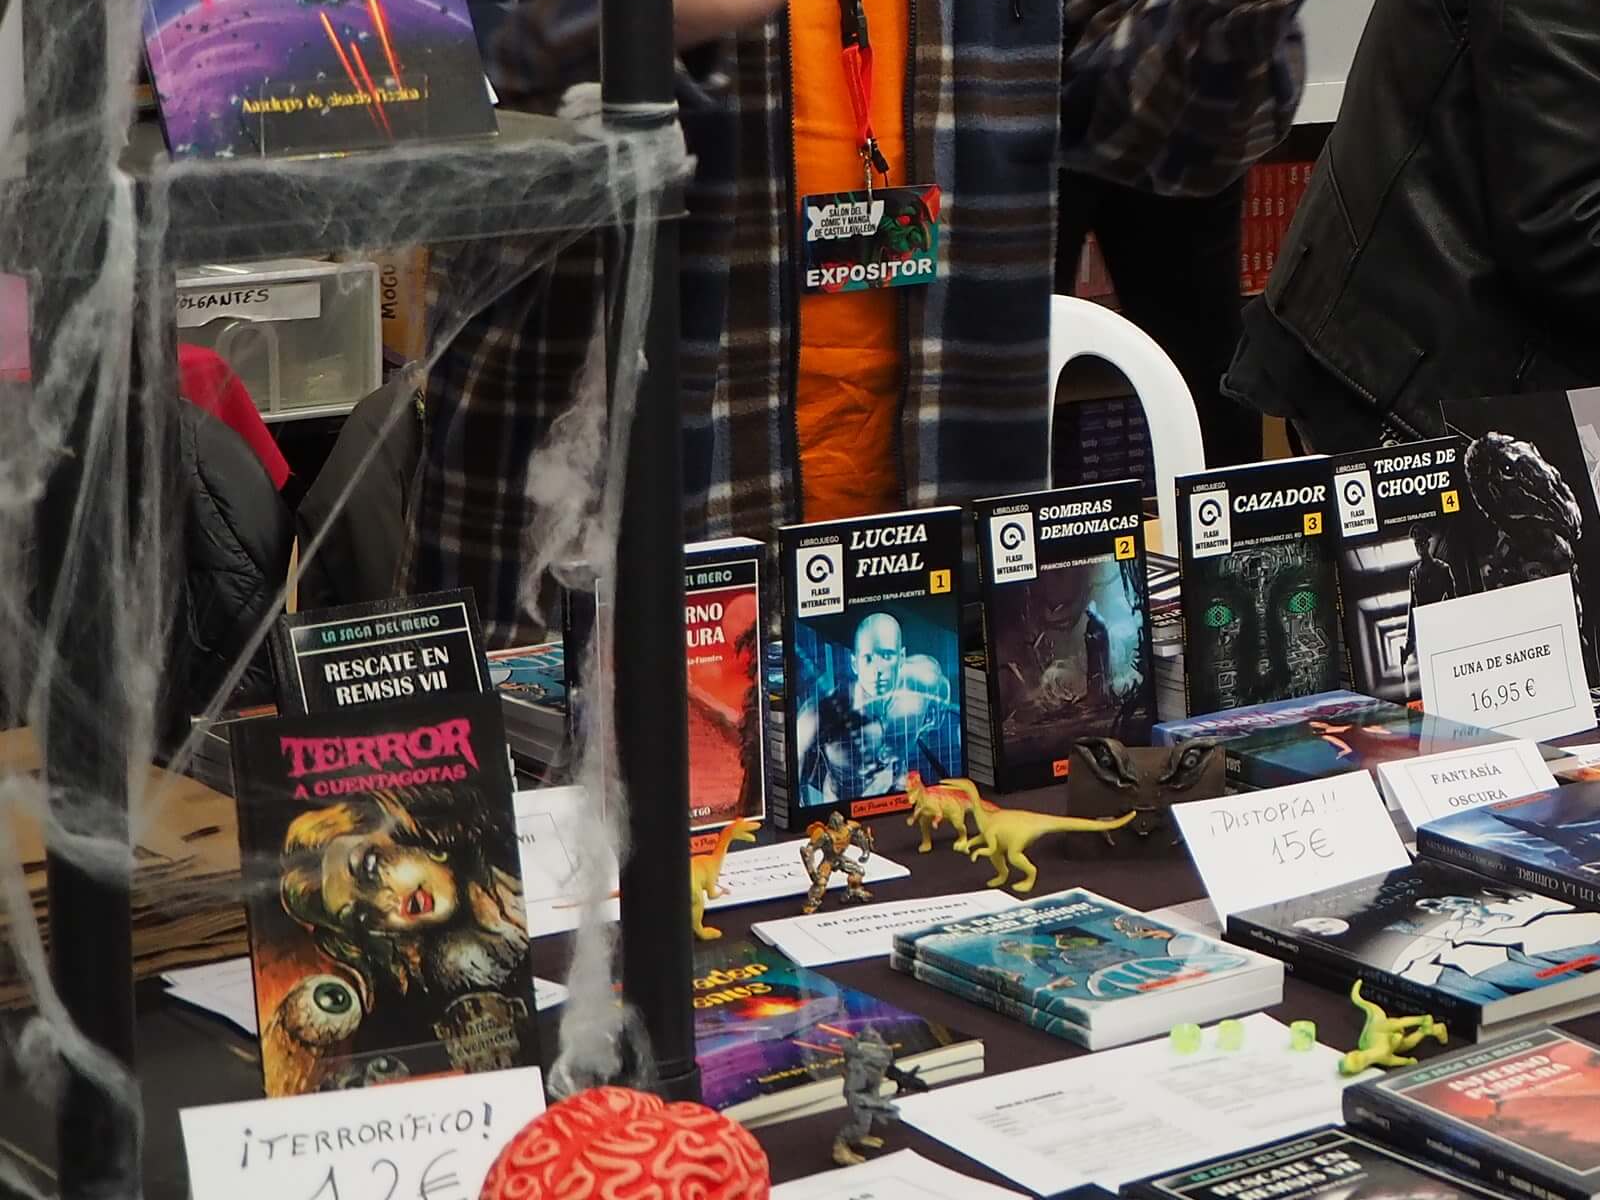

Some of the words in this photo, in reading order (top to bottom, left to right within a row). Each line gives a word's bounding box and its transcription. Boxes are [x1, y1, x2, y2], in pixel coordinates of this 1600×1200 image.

[821, 217, 841, 227] CÓMIC
[848, 215, 871, 225] MANGA
[829, 207, 849, 217] SALÓN
[850, 206, 863, 215] DEL
[823, 225, 854, 237] CASTILLA
[860, 223, 876, 233] LEÓN
[806, 258, 932, 287] EXPOSITOR
[177, 287, 270, 310] OLGANTES
[1374, 452, 1432, 474] TROPAS
[1436, 448, 1456, 464] DE
[1377, 471, 1450, 498] CHOQUE
[1039, 499, 1112, 521] SOMBRAS
[1233, 485, 1326, 513] CAZADOR
[1350, 509, 1365, 518] FLASH
[849, 524, 928, 550] LUCHA
[1040, 514, 1139, 540] DEMONIACAS
[1203, 530, 1219, 539] FLASH
[799, 535, 840, 547] LIBROJUEGO
[855, 552, 925, 578] FINAL
[1005, 554, 1023, 563] FLASH
[800, 597, 841, 609] INTERACTIVO
[811, 588, 830, 597] FLASH
[321, 629, 337, 643] LA
[339, 625, 373, 641] SAGA
[375, 621, 399, 636] DEL
[324, 651, 417, 683] RESCATE
[422, 646, 449, 665] EN
[1453, 661, 1483, 678] LUNA
[1486, 656, 1502, 670] DE
[1505, 644, 1551, 665] SANGRE
[336, 675, 415, 706] REMSIS
[418, 670, 448, 692] VII
[1471, 682, 1520, 712] 16,95
[1525, 678, 1537, 698] €
[279, 717, 480, 778] TERROR
[295, 784, 309, 800] A
[313, 763, 468, 795] CUENTAGOTAS
[1431, 762, 1502, 785] FANTASÍA
[1448, 788, 1508, 808] OSCURA
[1271, 827, 1335, 865] 15€
